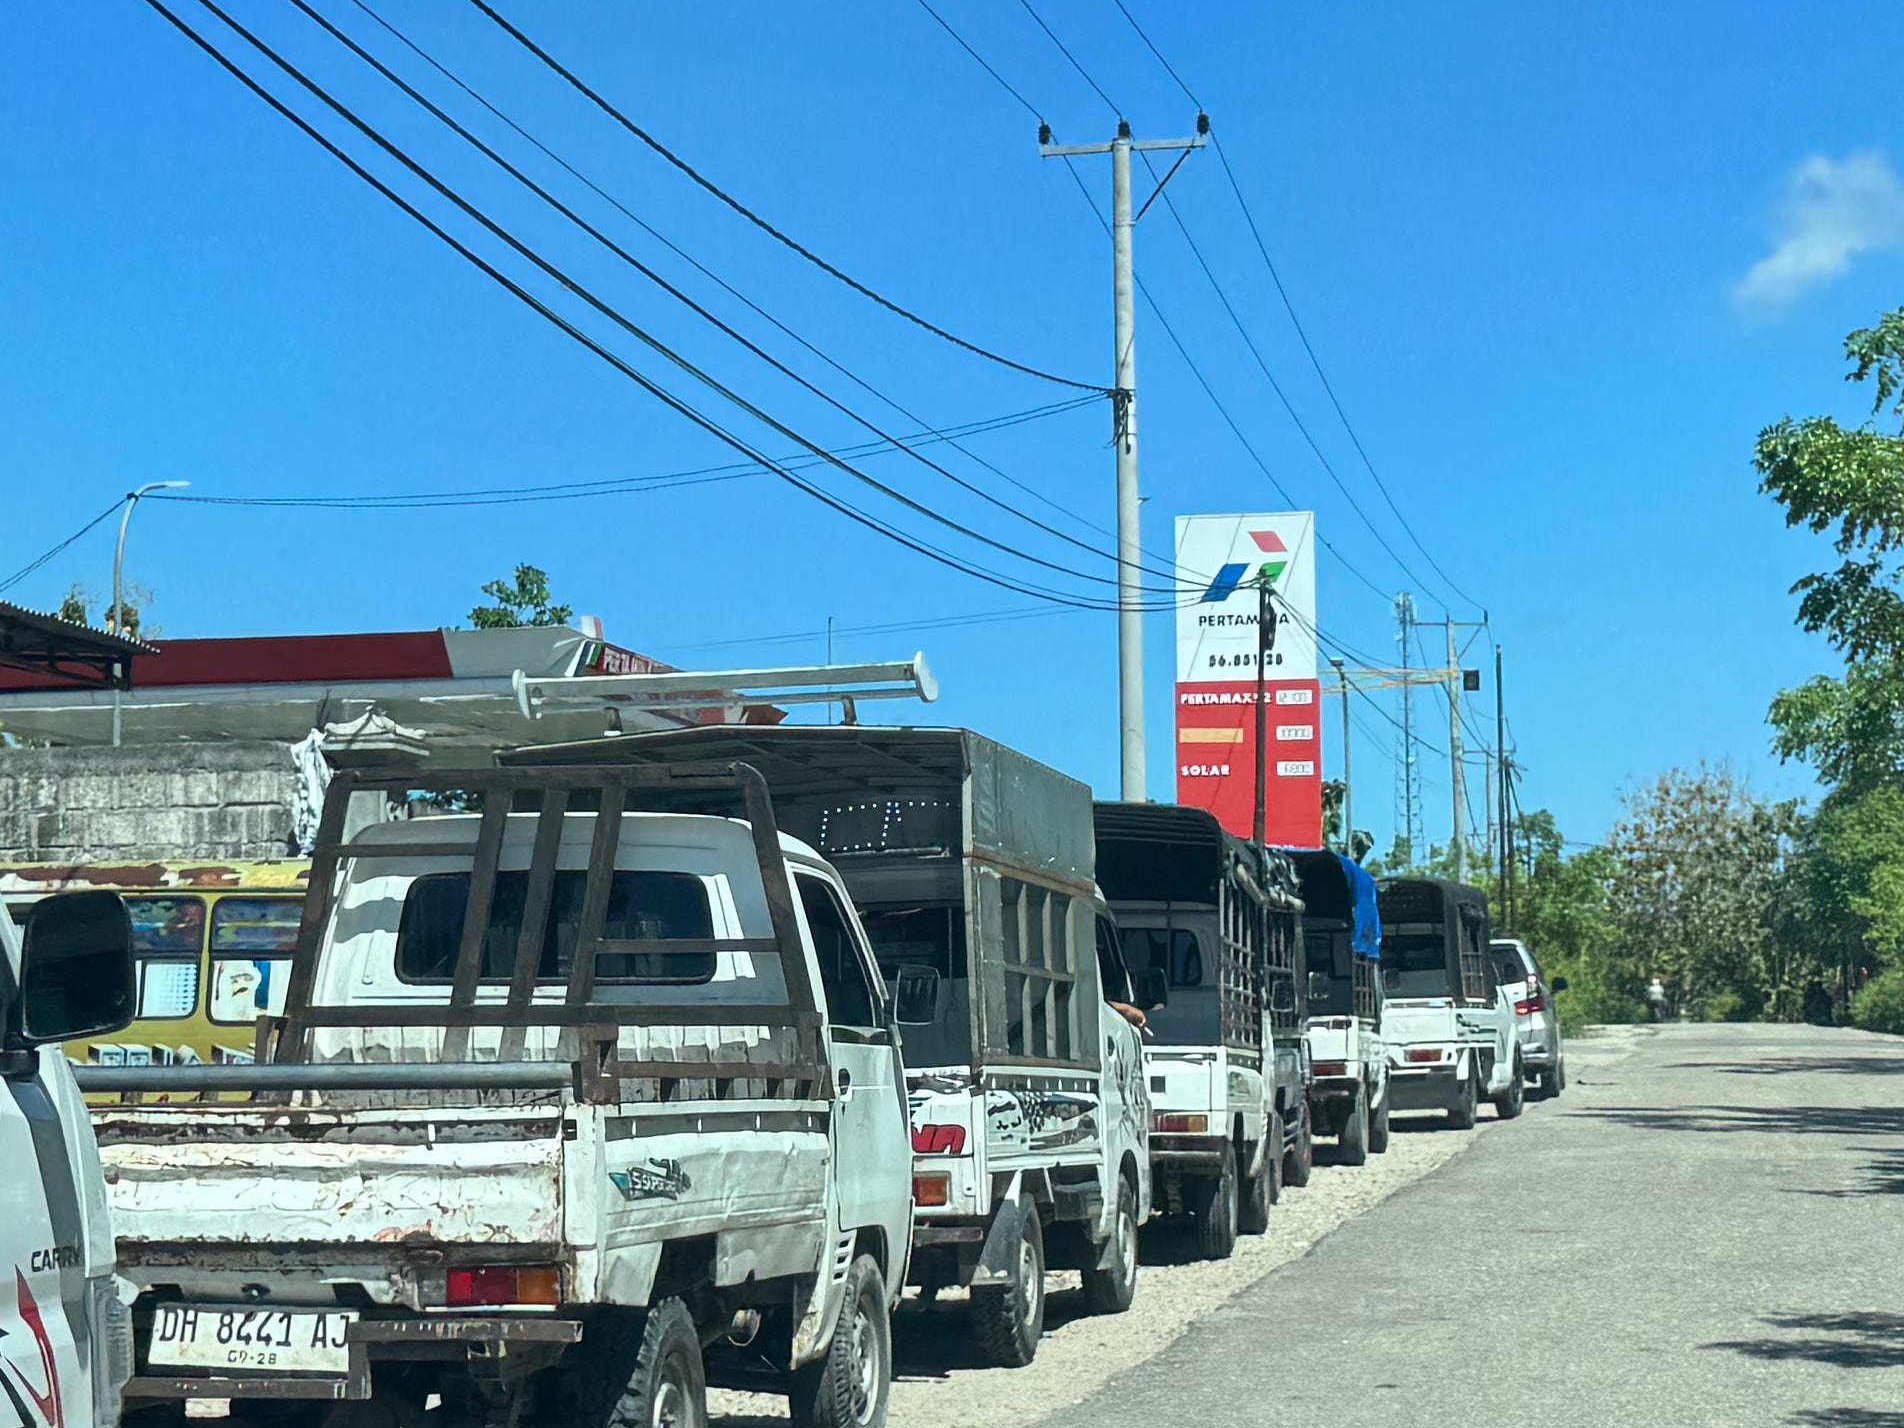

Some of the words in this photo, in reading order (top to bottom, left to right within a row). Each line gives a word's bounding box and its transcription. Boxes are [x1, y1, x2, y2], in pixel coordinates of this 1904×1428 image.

[1198, 612, 1290, 628] PERTAMA
[1180, 764, 1230, 776] SOLAR
[31, 1245, 81, 1272] CARRY
[158, 1309, 198, 1343] DH
[310, 1313, 351, 1349] AJ
